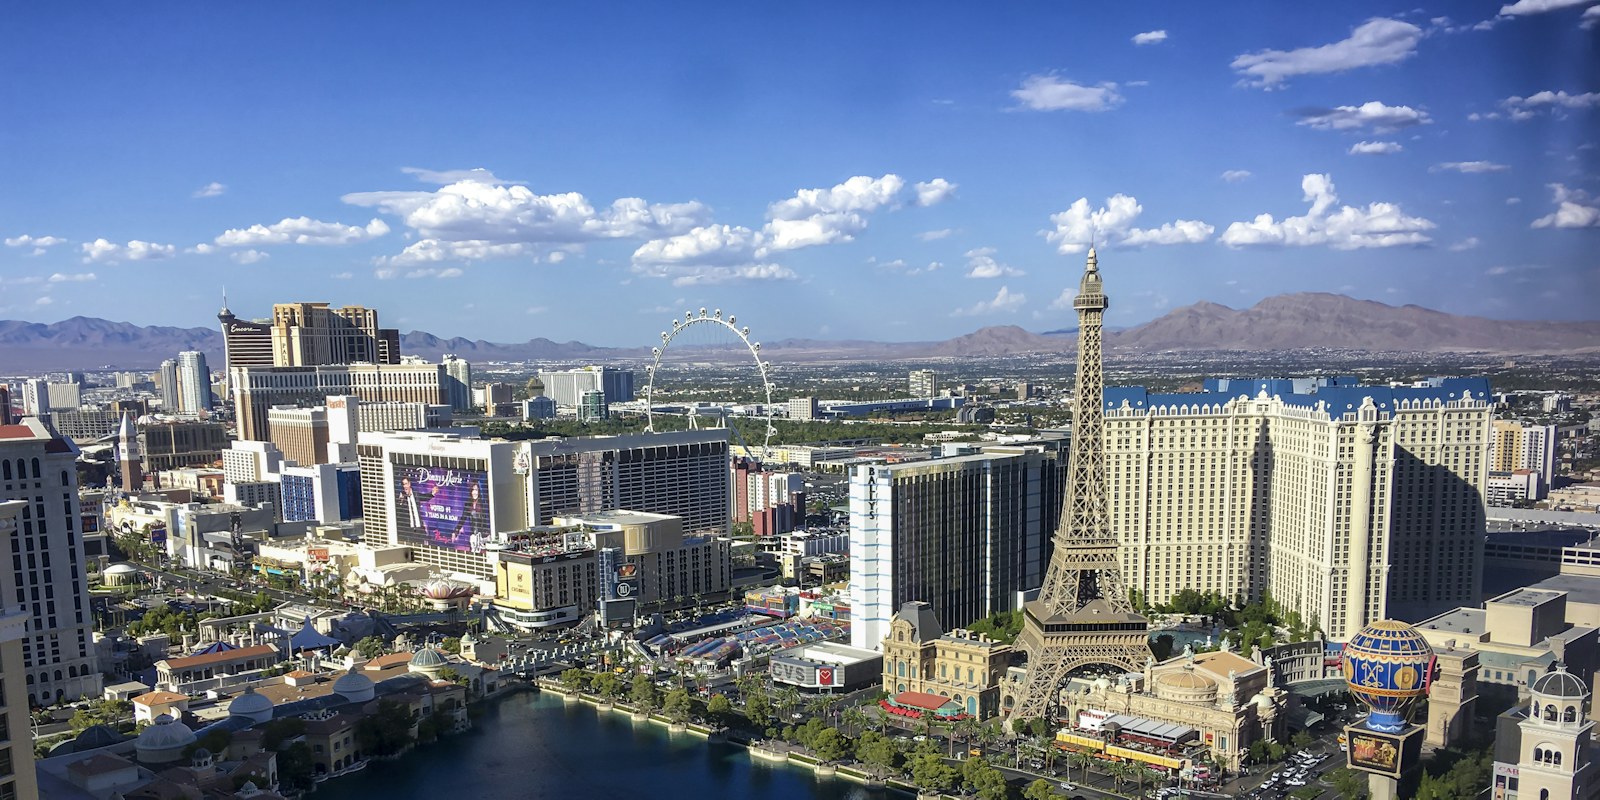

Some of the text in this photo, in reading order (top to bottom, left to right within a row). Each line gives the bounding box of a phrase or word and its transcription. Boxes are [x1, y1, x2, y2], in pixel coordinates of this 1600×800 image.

[230, 323, 261, 333] Encore
[430, 504, 445, 513] VOTED
[772, 662, 805, 683] CVS
